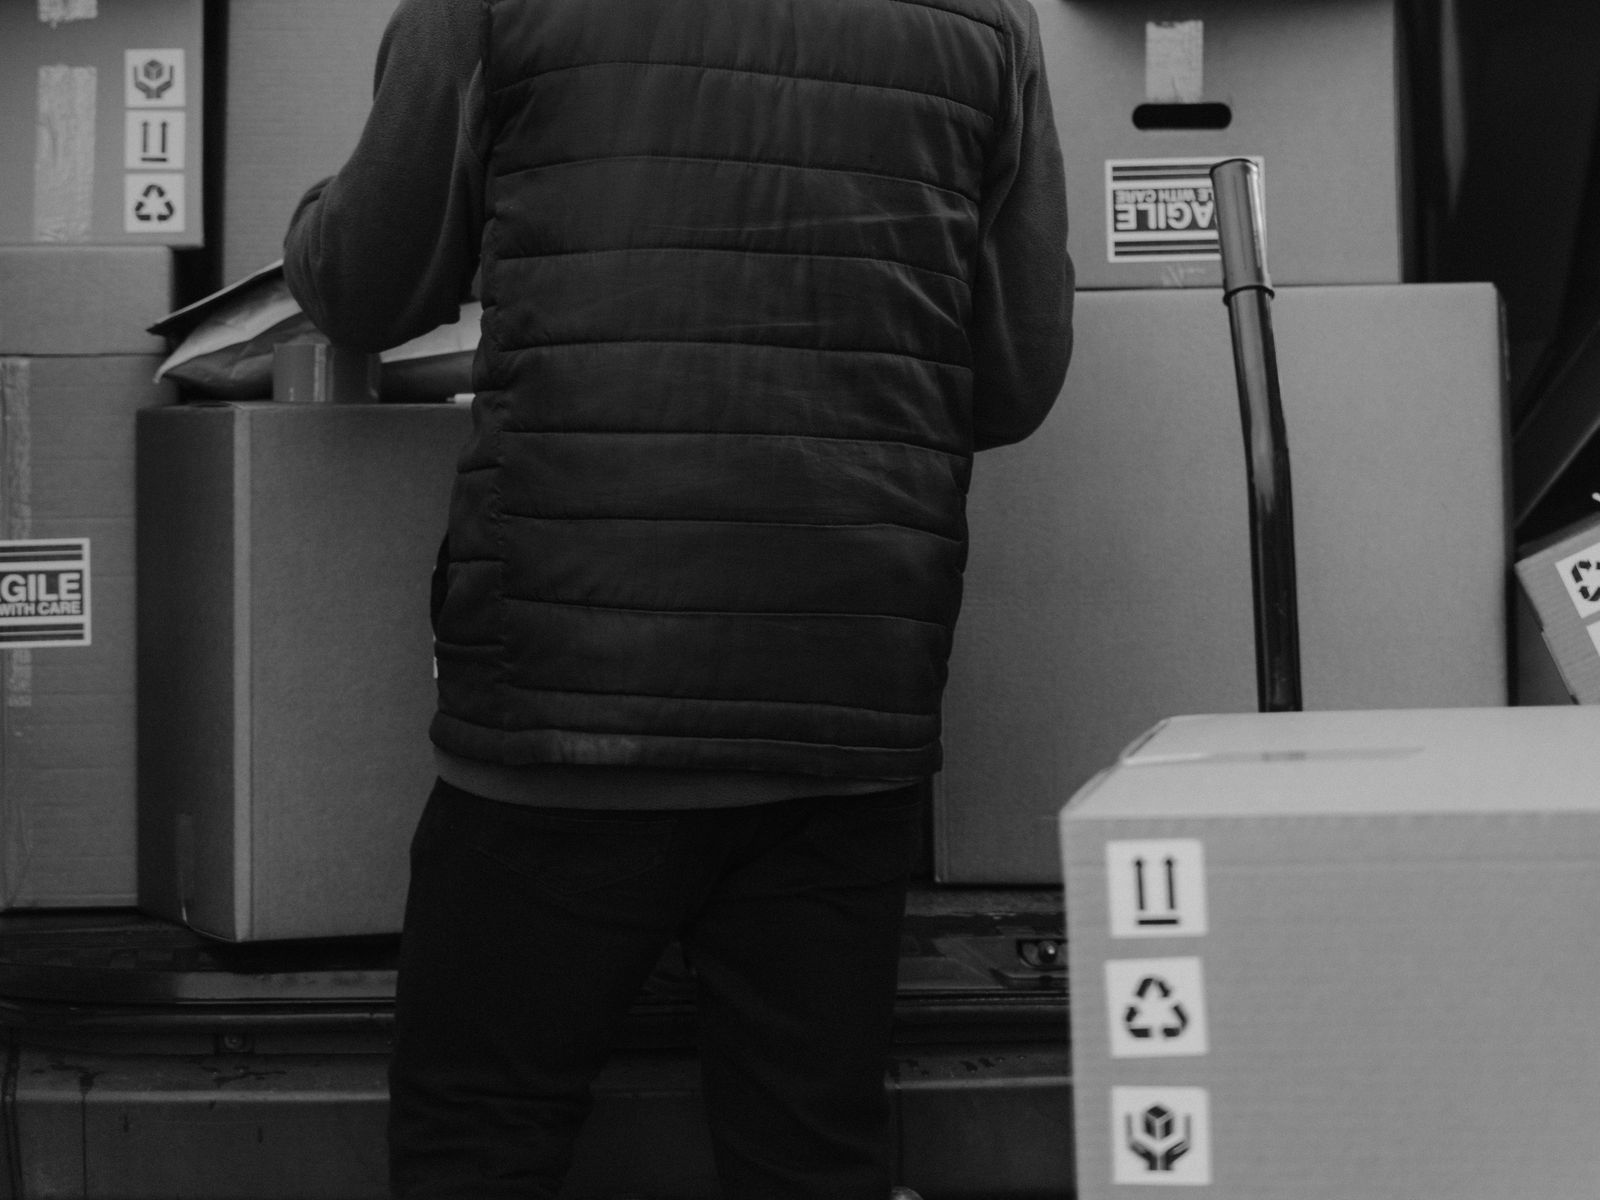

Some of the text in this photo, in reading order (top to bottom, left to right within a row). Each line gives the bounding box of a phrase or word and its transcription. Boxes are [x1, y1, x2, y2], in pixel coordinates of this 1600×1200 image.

[1115, 200, 1215, 230] AGILE
[0, 572, 82, 603] GILE
[37, 601, 82, 615] CARE
